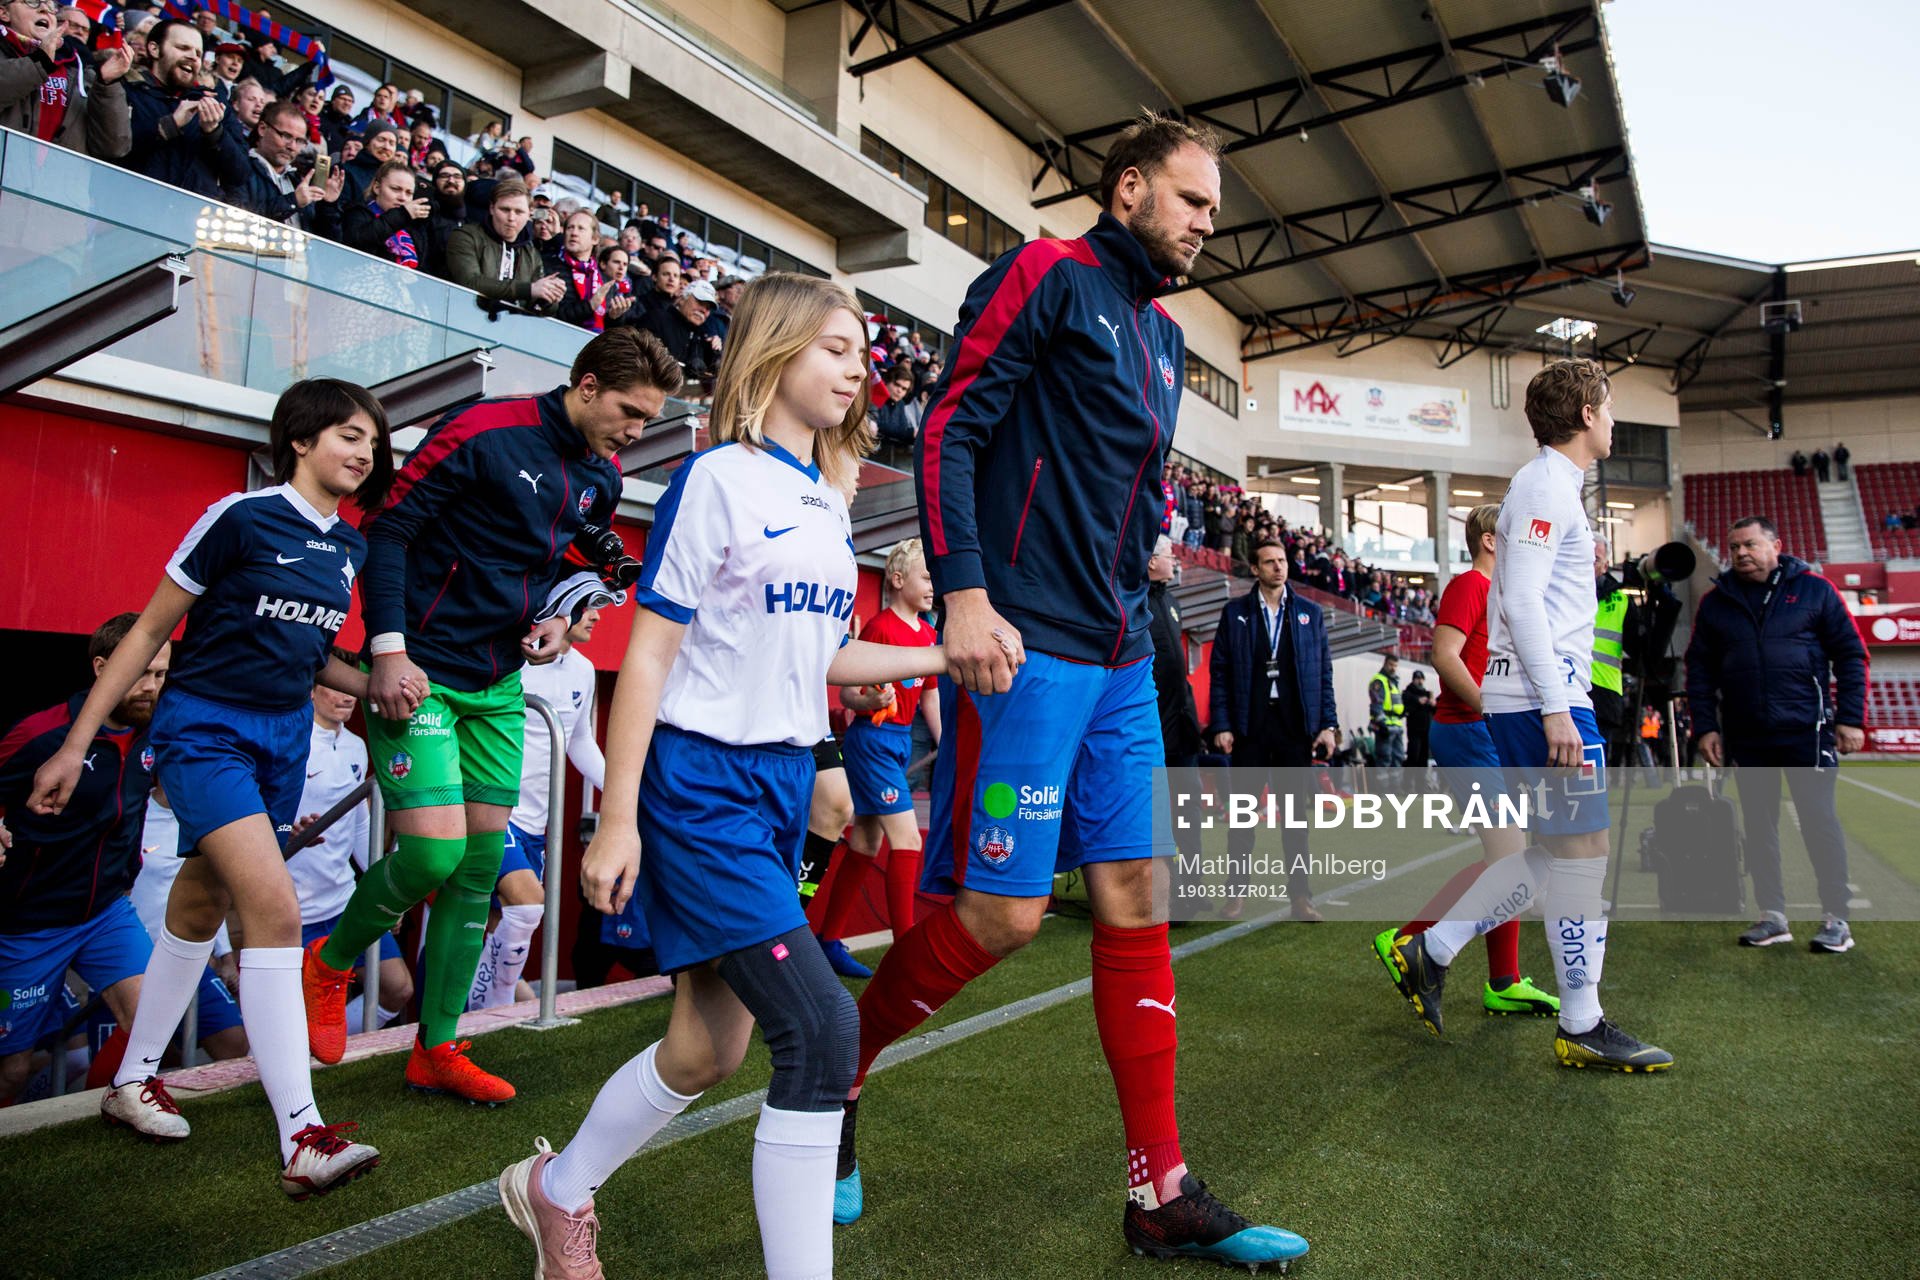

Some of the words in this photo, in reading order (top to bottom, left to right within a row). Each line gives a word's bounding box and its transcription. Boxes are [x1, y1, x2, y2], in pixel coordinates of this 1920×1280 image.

[1294, 380, 1341, 416] MAX
[306, 540, 337, 554] stadium
[410, 711, 442, 727] Solid
[1020, 785, 1059, 805] Solid
[1567, 800, 1579, 821] 7
[1559, 914, 1586, 966] suez
[13, 984, 45, 1001] Solid
[472, 962, 493, 1003] suez
